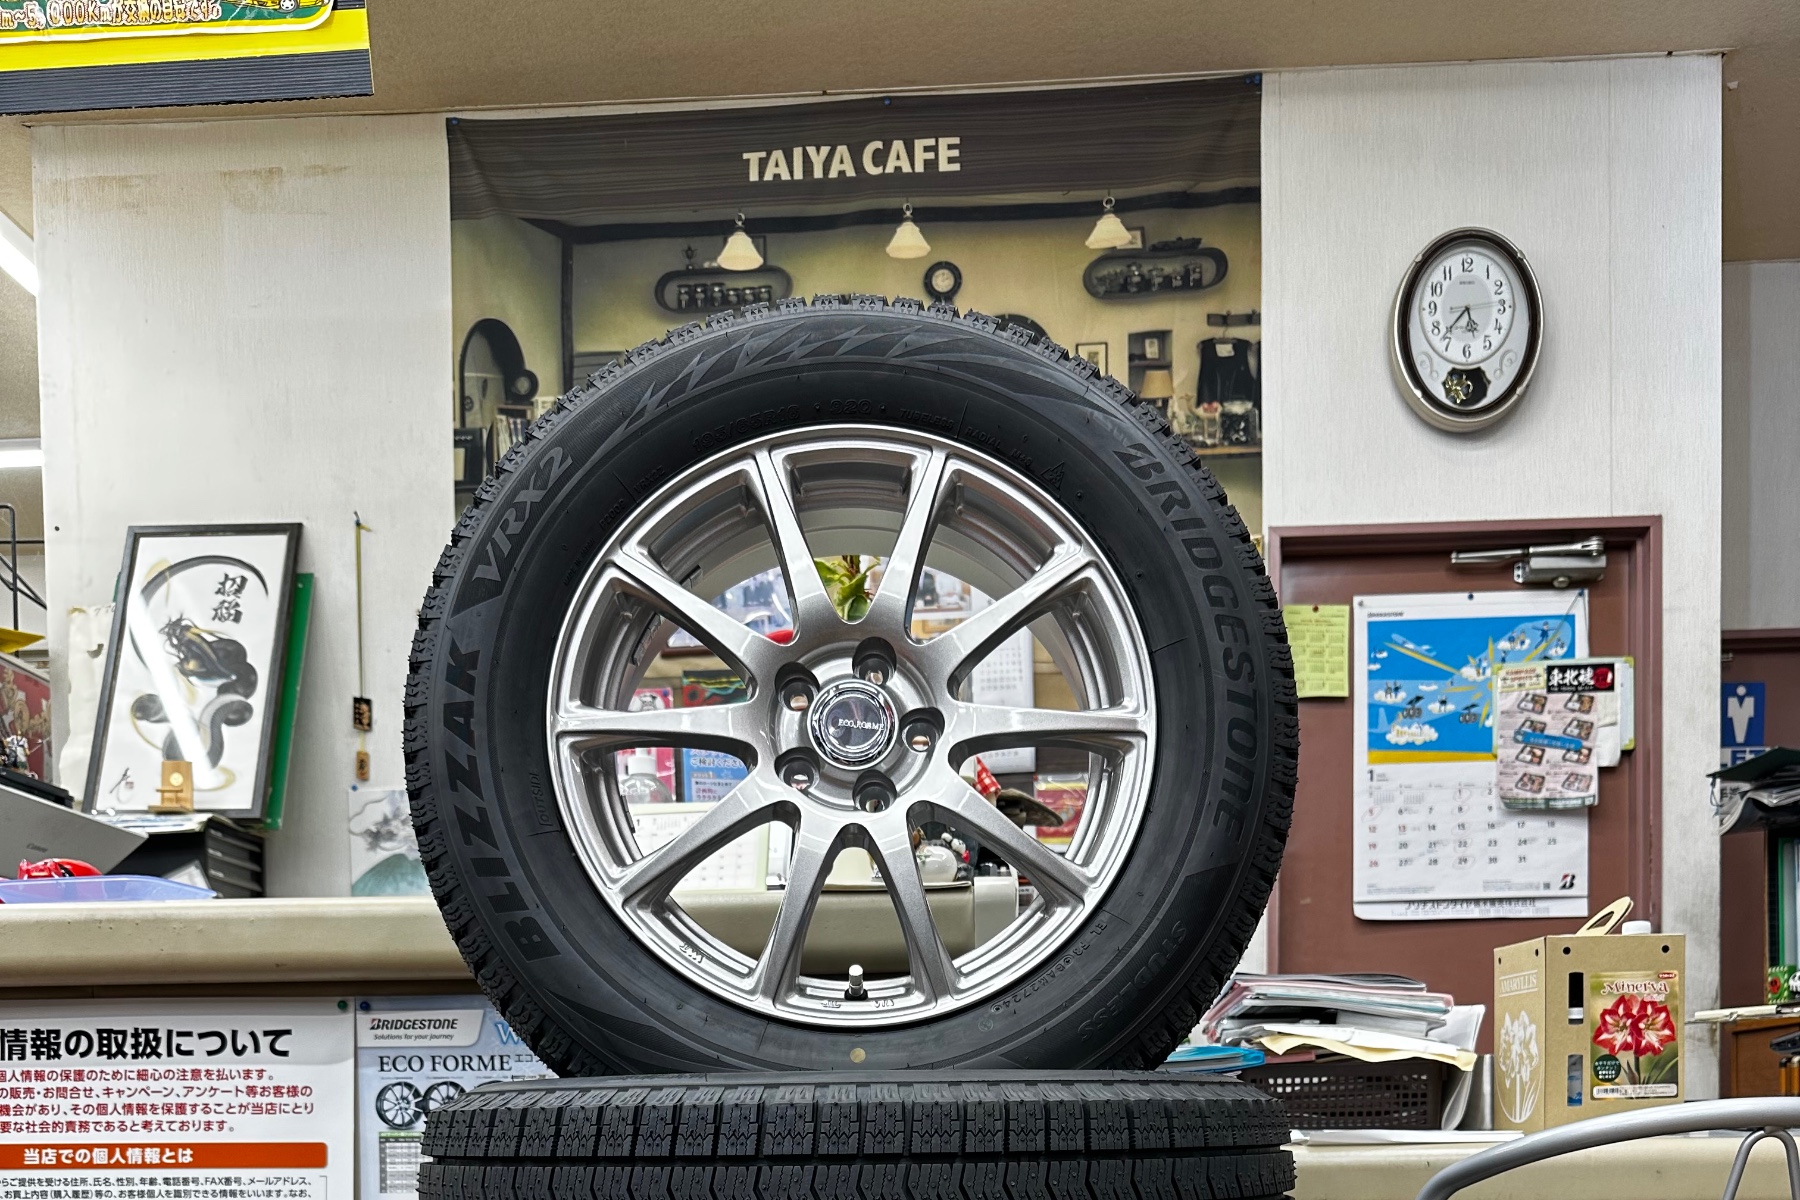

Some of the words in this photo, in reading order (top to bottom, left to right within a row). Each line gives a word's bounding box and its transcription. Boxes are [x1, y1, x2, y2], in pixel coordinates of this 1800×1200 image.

[742, 145, 856, 182] TAIYA
[862, 137, 961, 176] CAFE
[1443, 265, 1452, 281] 11
[1461, 257, 1474, 273] 12
[1486, 264, 1490, 280] 1
[1431, 281, 1443, 297] 10
[1494, 279, 1503, 295] 2
[1428, 300, 1437, 316] 9
[1497, 299, 1506, 314] 3
[1431, 321, 1441, 336] 8
[1494, 318, 1502, 334] 4
[1443, 337, 1452, 352] 7
[1462, 343, 1471, 359] 6
[1483, 335, 1492, 351] 5
[472, 446, 573, 582] VRX2
[1112, 442, 1259, 838] BRIDGESTONE
[1368, 770, 1374, 782] 1
[443, 634, 562, 964] BLIZZAK
[1078, 920, 1187, 1041] STUDLESS
[1500, 974, 1537, 993] AMARYLLIS
[1601, 980, 1669, 995] Minerva
[370, 1019, 458, 1030] BRIDGESTONE
[429, 1033, 454, 1041] journey
[496, 1023, 520, 1044] W
[378, 1055, 424, 1072] ECO
[431, 1055, 512, 1071] FORME
[515, 1054, 540, 1063] エコ
[0, 1120, 235, 1134] 要な社会的責務であると考えております。
[23, 1148, 194, 1165] 当店での個人情報とは
[0, 1176, 312, 1188] らご提供を受ける住所、氏名、性別、年齢、電話番号、FAX番号、メールアドレス、
